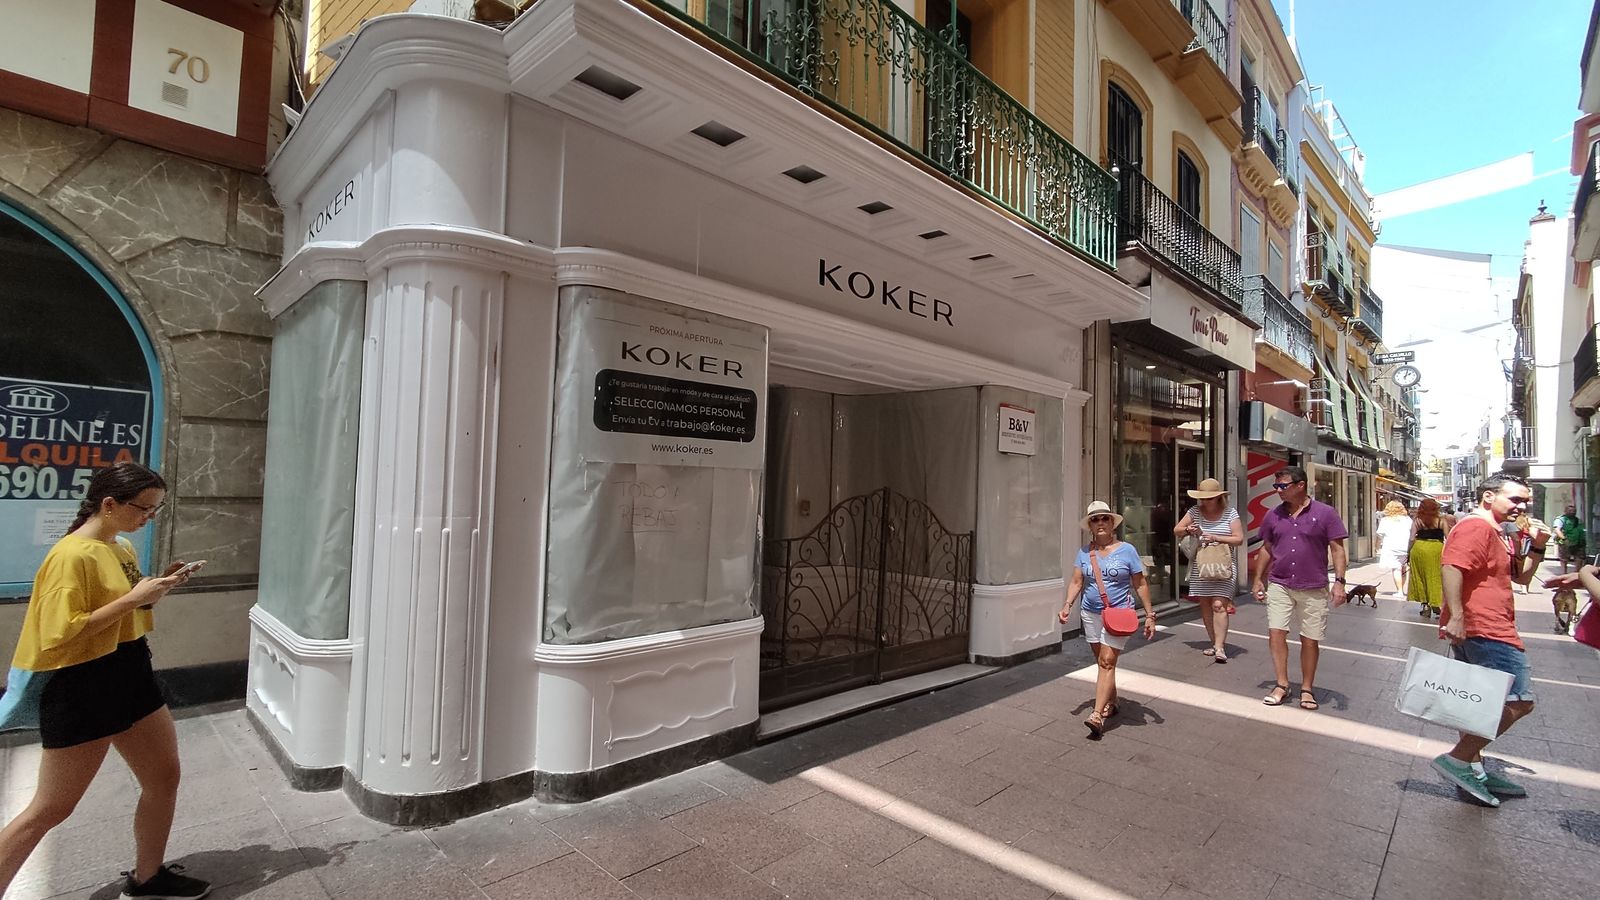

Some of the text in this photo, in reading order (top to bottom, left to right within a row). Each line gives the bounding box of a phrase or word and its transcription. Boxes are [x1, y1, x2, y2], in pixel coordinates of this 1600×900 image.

[167, 47, 210, 84] 70
[308, 179, 354, 243] KOKER
[818, 258, 954, 327] KOKER
[684, 332, 724, 346] APERTURA
[621, 341, 744, 379] KOKER
[648, 383, 671, 393] trabajar
[679, 388, 698, 396] moda
[614, 396, 746, 420] SELECCIONAMOS PERSONAL
[637, 417, 647, 425] tu
[648, 416, 660, 426] CV
[666, 418, 746, 434] trabajo@koker.es
[1008, 417, 1029, 433] B&V
[651, 442, 714, 455] www.koker.es
[1423, 680, 1482, 703] MANGO
